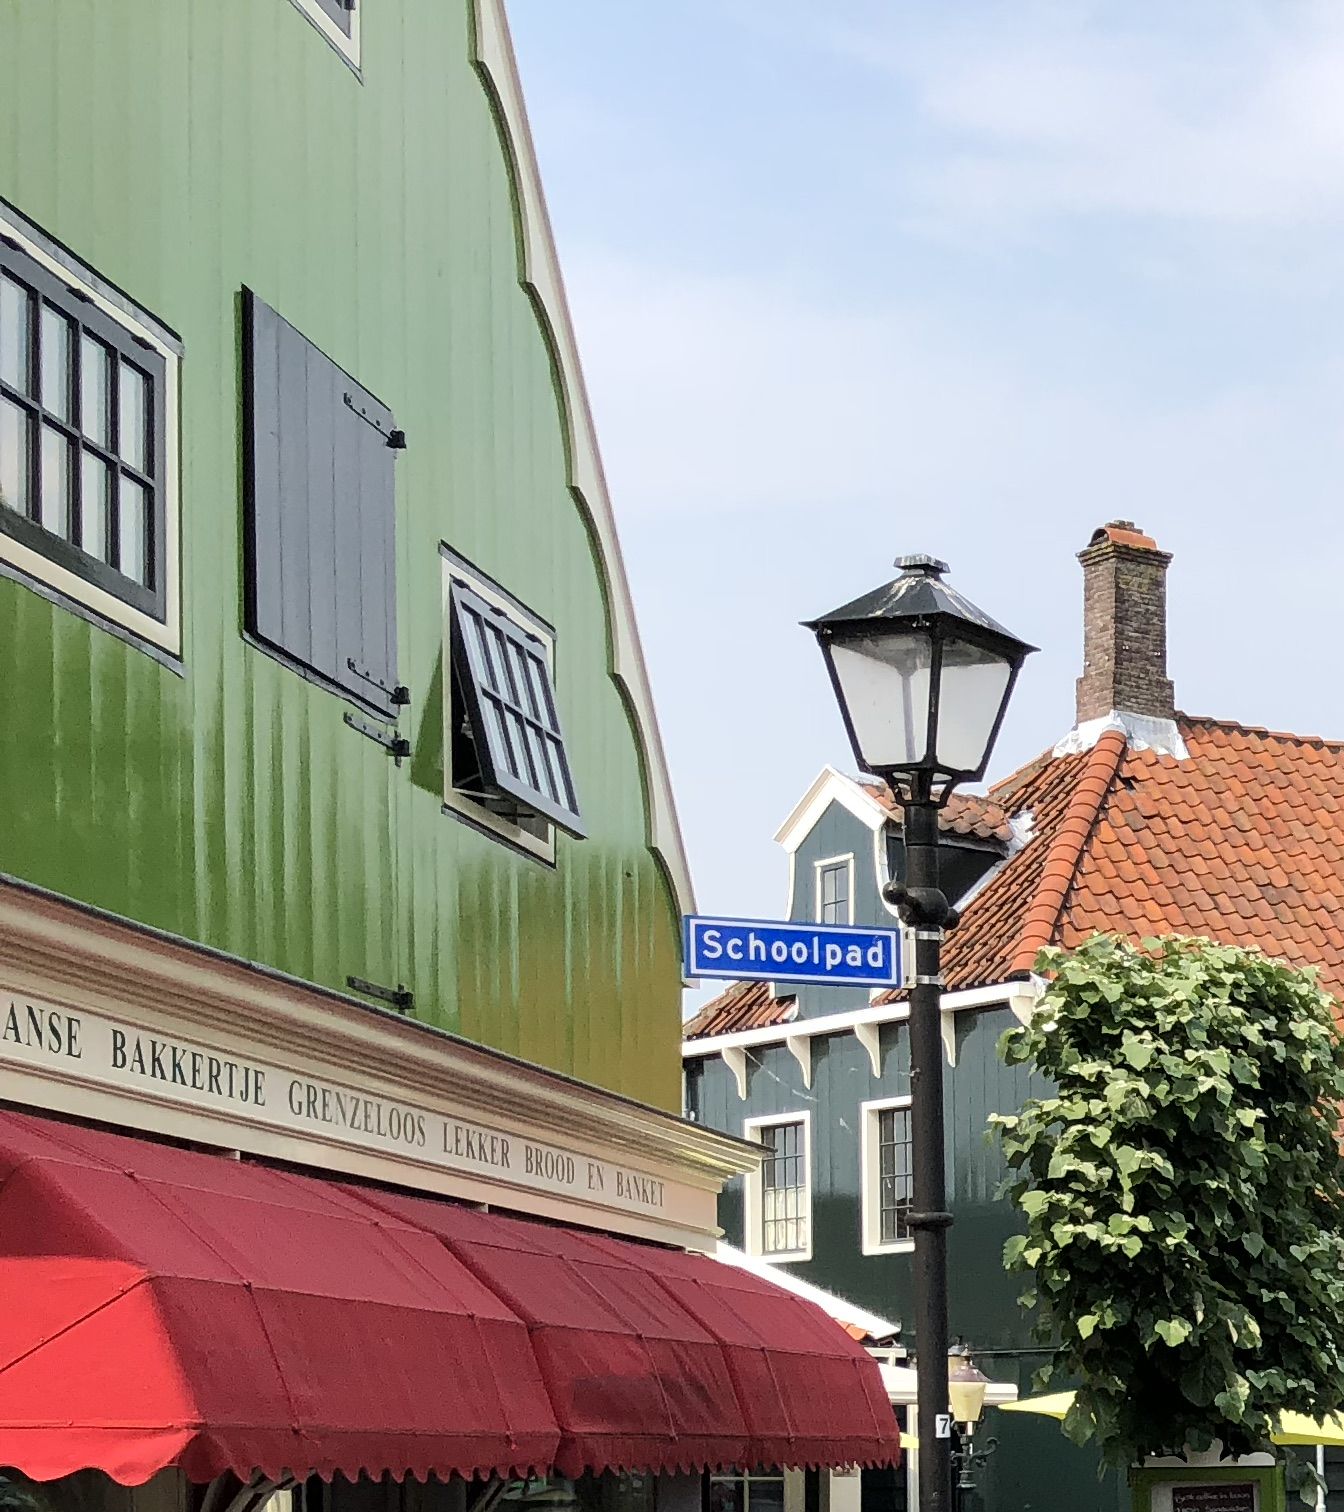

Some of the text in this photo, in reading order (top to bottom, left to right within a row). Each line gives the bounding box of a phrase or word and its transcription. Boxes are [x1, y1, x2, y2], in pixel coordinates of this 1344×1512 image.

[703, 929, 884, 971] Schoolpad
[111, 1029, 267, 1107] BAKKERTJE
[288, 1079, 427, 1148] GRENZELOOS
[442, 1121, 512, 1169] LEKKER
[525, 1145, 575, 1185] BROOD
[588, 1162, 605, 1191] EN
[616, 1171, 665, 1208] BANKET
[939, 1417, 949, 1435] 7
